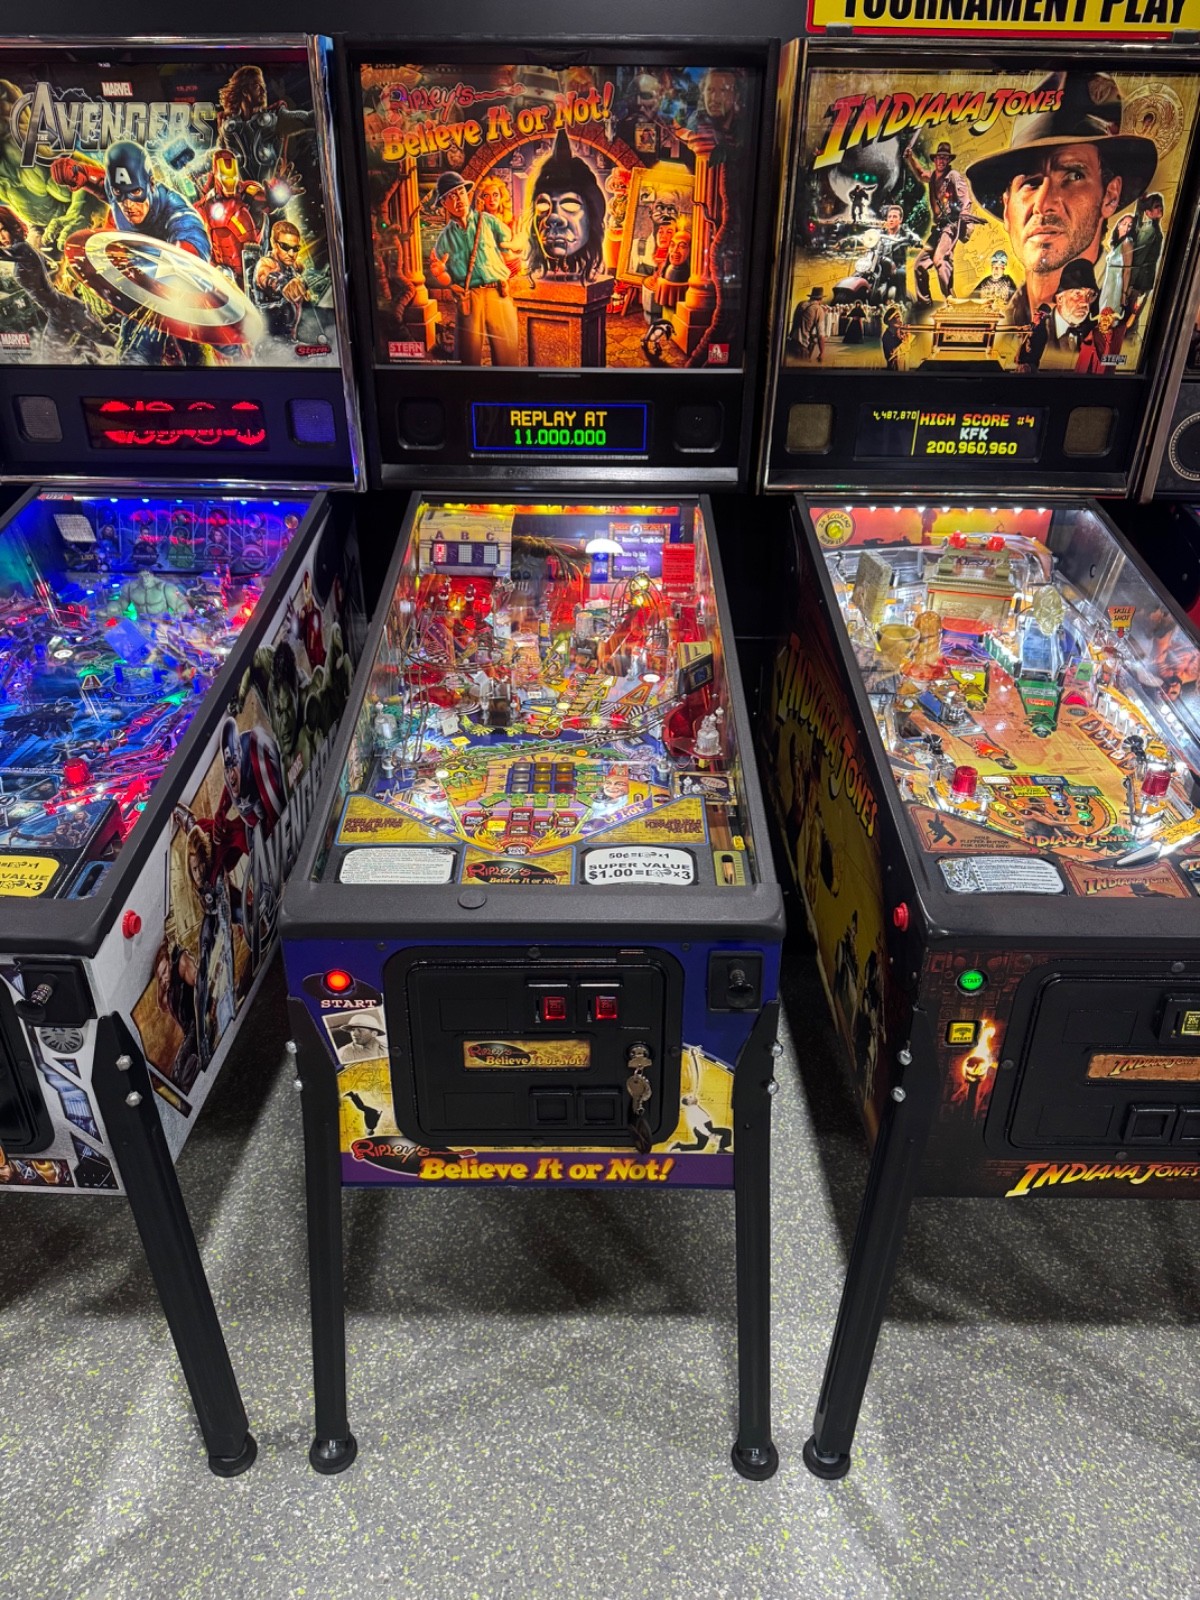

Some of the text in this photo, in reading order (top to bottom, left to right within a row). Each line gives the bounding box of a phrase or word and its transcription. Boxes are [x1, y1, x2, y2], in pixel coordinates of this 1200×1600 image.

[845, 0, 1186, 24] TOURNAMENT PLAY
[101, 82, 133, 96] MARVEL
[20, 82, 215, 168] AVENGERS
[382, 81, 616, 161] Believe It or Not!
[813, 87, 1065, 171] INDIANA JONES
[1, 333, 29, 345] MARVEL
[390, 343, 423, 352] STERN
[510, 410, 608, 427] REPLAY AT
[919, 413, 1035, 427] HIGH SCORE #4
[514, 428, 606, 446] 11,000,000
[959, 427, 990, 440] KFK
[926, 440, 1018, 455] 200,960,960
[436, 531, 494, 540] A B C
[828, 734, 878, 838] JONES
[1020, 835, 1086, 847] NDIANA
[2, 873, 50, 881] VALUE
[467, 863, 532, 879] Ripley's
[1084, 878, 1142, 895] INDIANA
[321, 1000, 376, 1009] START
[485, 1055, 588, 1066] Believe It or Not!
[1108, 1058, 1166, 1077] INDIANA
[351, 1140, 430, 1163] Ripley's
[418, 1157, 675, 1182] Believe It or Not!
[1005, 1162, 1200, 1198] INDIANA JONES
